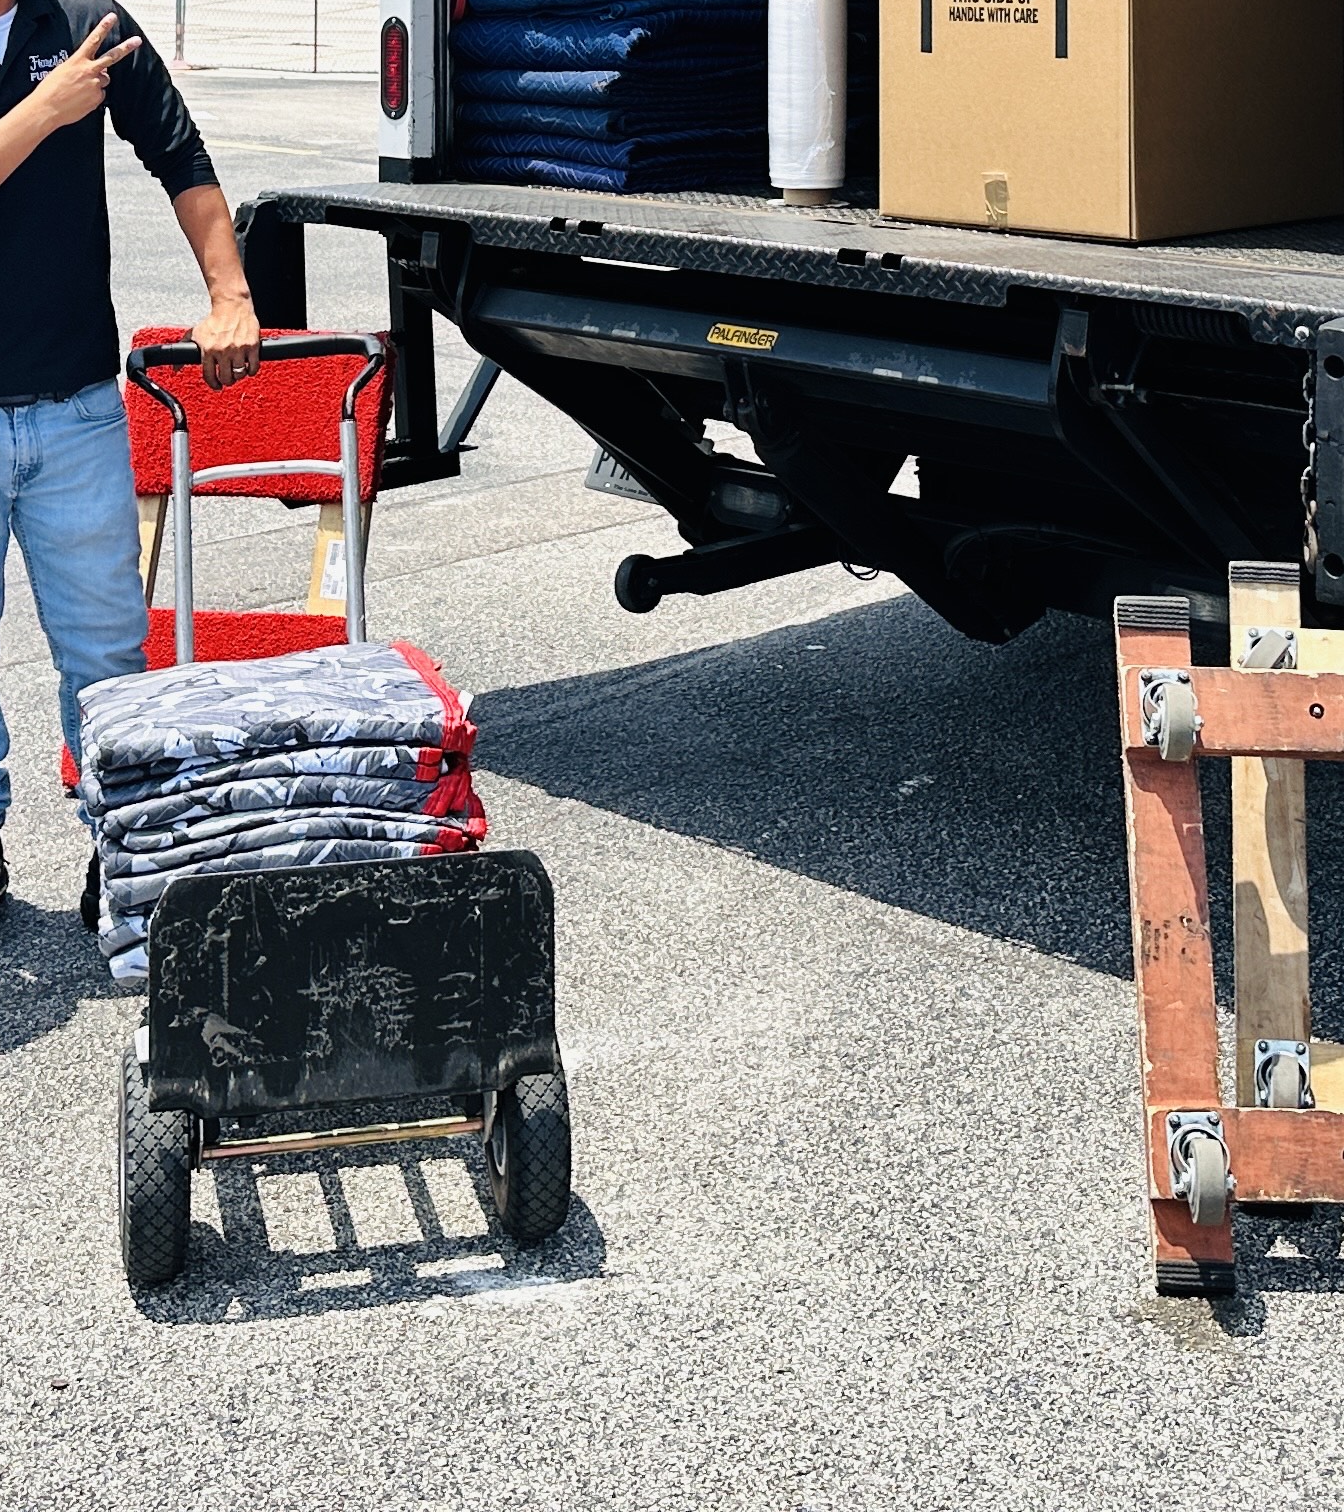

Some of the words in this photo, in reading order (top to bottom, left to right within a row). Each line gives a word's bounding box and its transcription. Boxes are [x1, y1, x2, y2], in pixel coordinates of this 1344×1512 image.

[949, 6, 985, 22] HANDLE
[987, 7, 1011, 23] WITH
[1013, 7, 1038, 24] CARE
